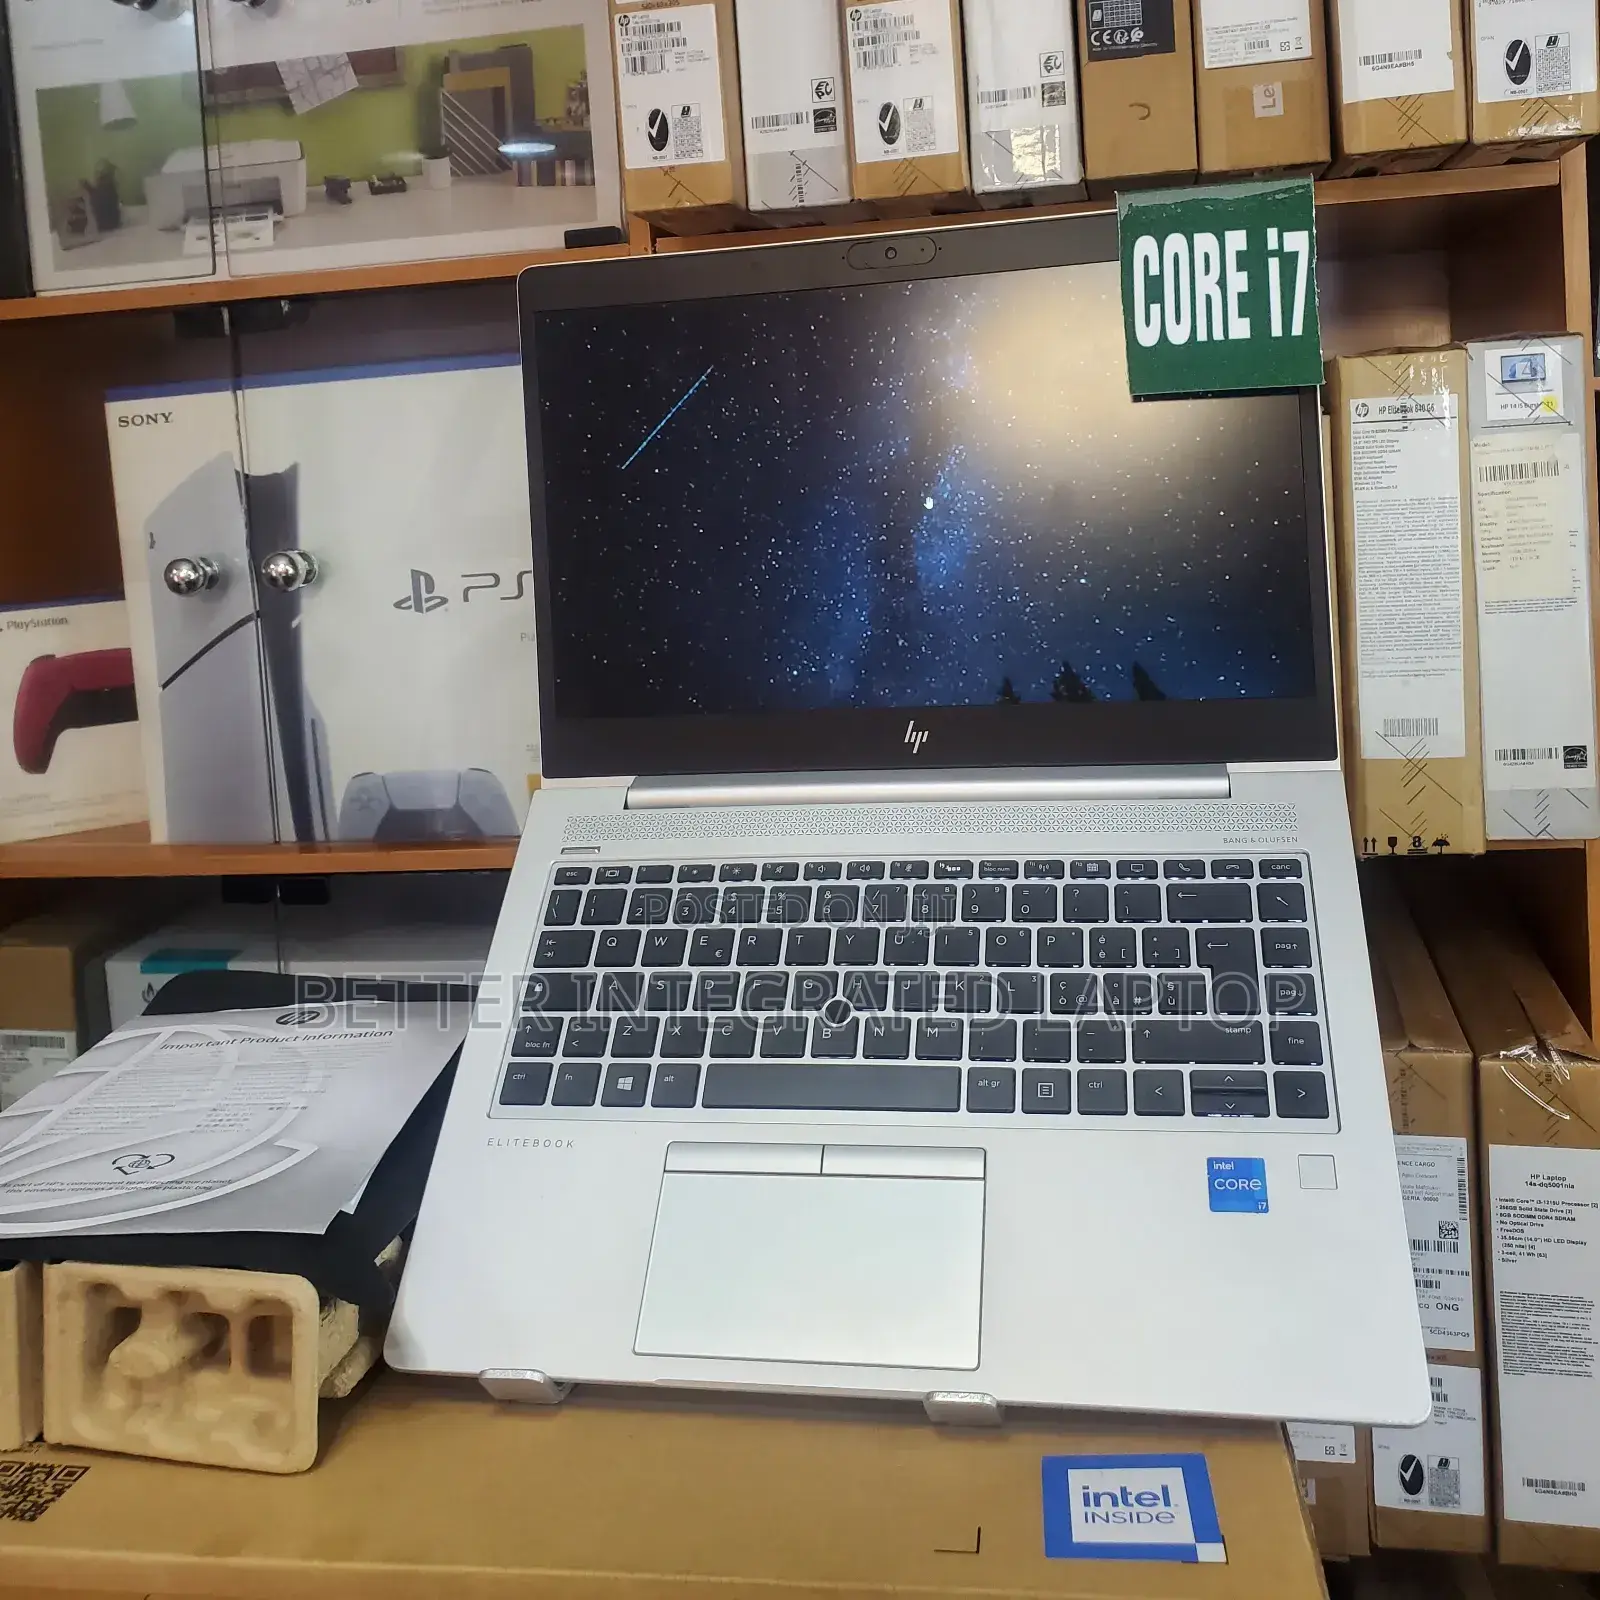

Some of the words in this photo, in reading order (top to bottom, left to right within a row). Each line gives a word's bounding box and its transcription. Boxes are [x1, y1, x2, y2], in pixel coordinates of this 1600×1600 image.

[1133, 229, 1251, 347] CORE
[1267, 227, 1309, 337] i7
[1378, 406, 1386, 414] HP
[118, 412, 173, 428] SONY
[6, 616, 68, 632] PlayStation
[1258, 836, 1298, 844] OLUFSEN
[590, 908, 595, 916] 1
[635, 908, 643, 916] 2
[682, 907, 690, 916] 3
[728, 906, 736, 915] 4
[776, 906, 782, 914] 5
[824, 906, 830, 914] 6
[872, 904, 879, 913] 7
[922, 904, 929, 914] 8
[971, 904, 978, 914] 9
[606, 937, 616, 948] Q
[654, 936, 668, 946] W
[700, 936, 708, 946] E
[748, 936, 756, 945] R
[796, 936, 804, 944] T
[846, 935, 854, 944] Y
[895, 936, 904, 944] U
[944, 936, 948, 944] I
[996, 936, 1006, 946] O
[1047, 936, 1056, 946] P
[609, 980, 618, 990] A
[656, 980, 665, 990] S
[704, 980, 714, 990] D
[752, 980, 762, 989] F
[804, 980, 813, 989] G
[852, 980, 862, 989] H
[903, 980, 911, 990] J
[956, 980, 964, 990] K
[1008, 981, 1016, 992] L
[622, 1026, 632, 1036] Z
[672, 1026, 682, 1036] X
[722, 1026, 732, 1036] C
[772, 1026, 782, 1035] V
[822, 1028, 832, 1038] B
[874, 1027, 884, 1037] N
[928, 1028, 938, 1038] M
[1225, 1026, 1252, 1034] stamp
[161, 1038, 236, 1050] Important
[240, 1034, 300, 1045] Product
[302, 1030, 394, 1042] Information
[487, 1138, 574, 1148] ELITEBOOK
[1213, 1161, 1234, 1170] intel
[1414, 1160, 1436, 1168] CARGO
[1542, 1174, 1567, 1182] Laptop
[1214, 1178, 1262, 1190] CORE
[1258, 1202, 1266, 1210] i7
[1436, 1302, 1459, 1311] ONG
[1082, 1484, 1172, 1508] intel
